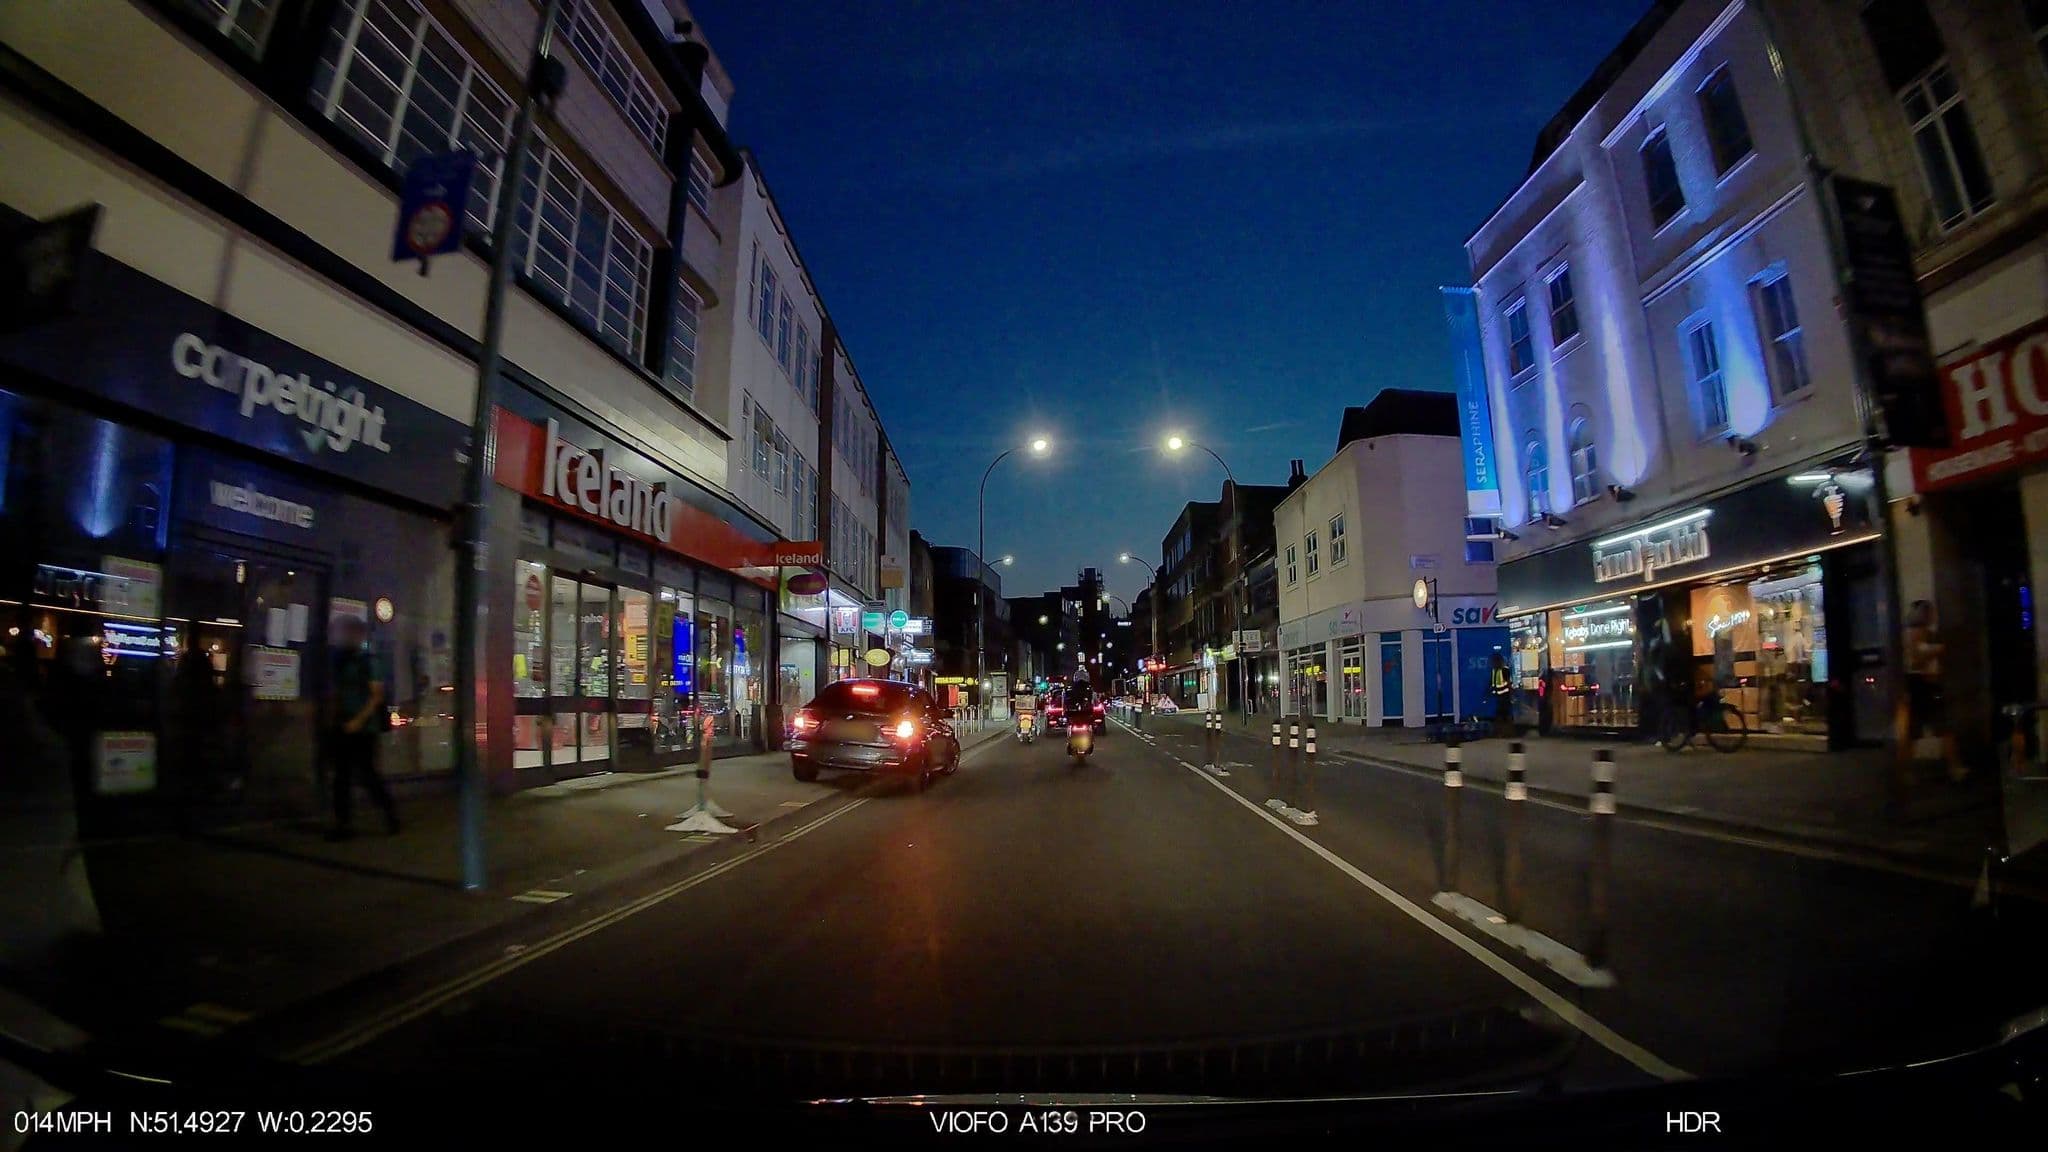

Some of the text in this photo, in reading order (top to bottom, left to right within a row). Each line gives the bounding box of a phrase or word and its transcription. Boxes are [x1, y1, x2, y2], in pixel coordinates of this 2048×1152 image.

[172, 332, 391, 452] carpetright
[1468, 400, 1487, 484] SERAPHINE
[211, 480, 314, 529] welcome
[543, 417, 672, 543] Iceland
[775, 553, 819, 564] Iceland
[1565, 619, 1630, 639] Kebabs Done Right
